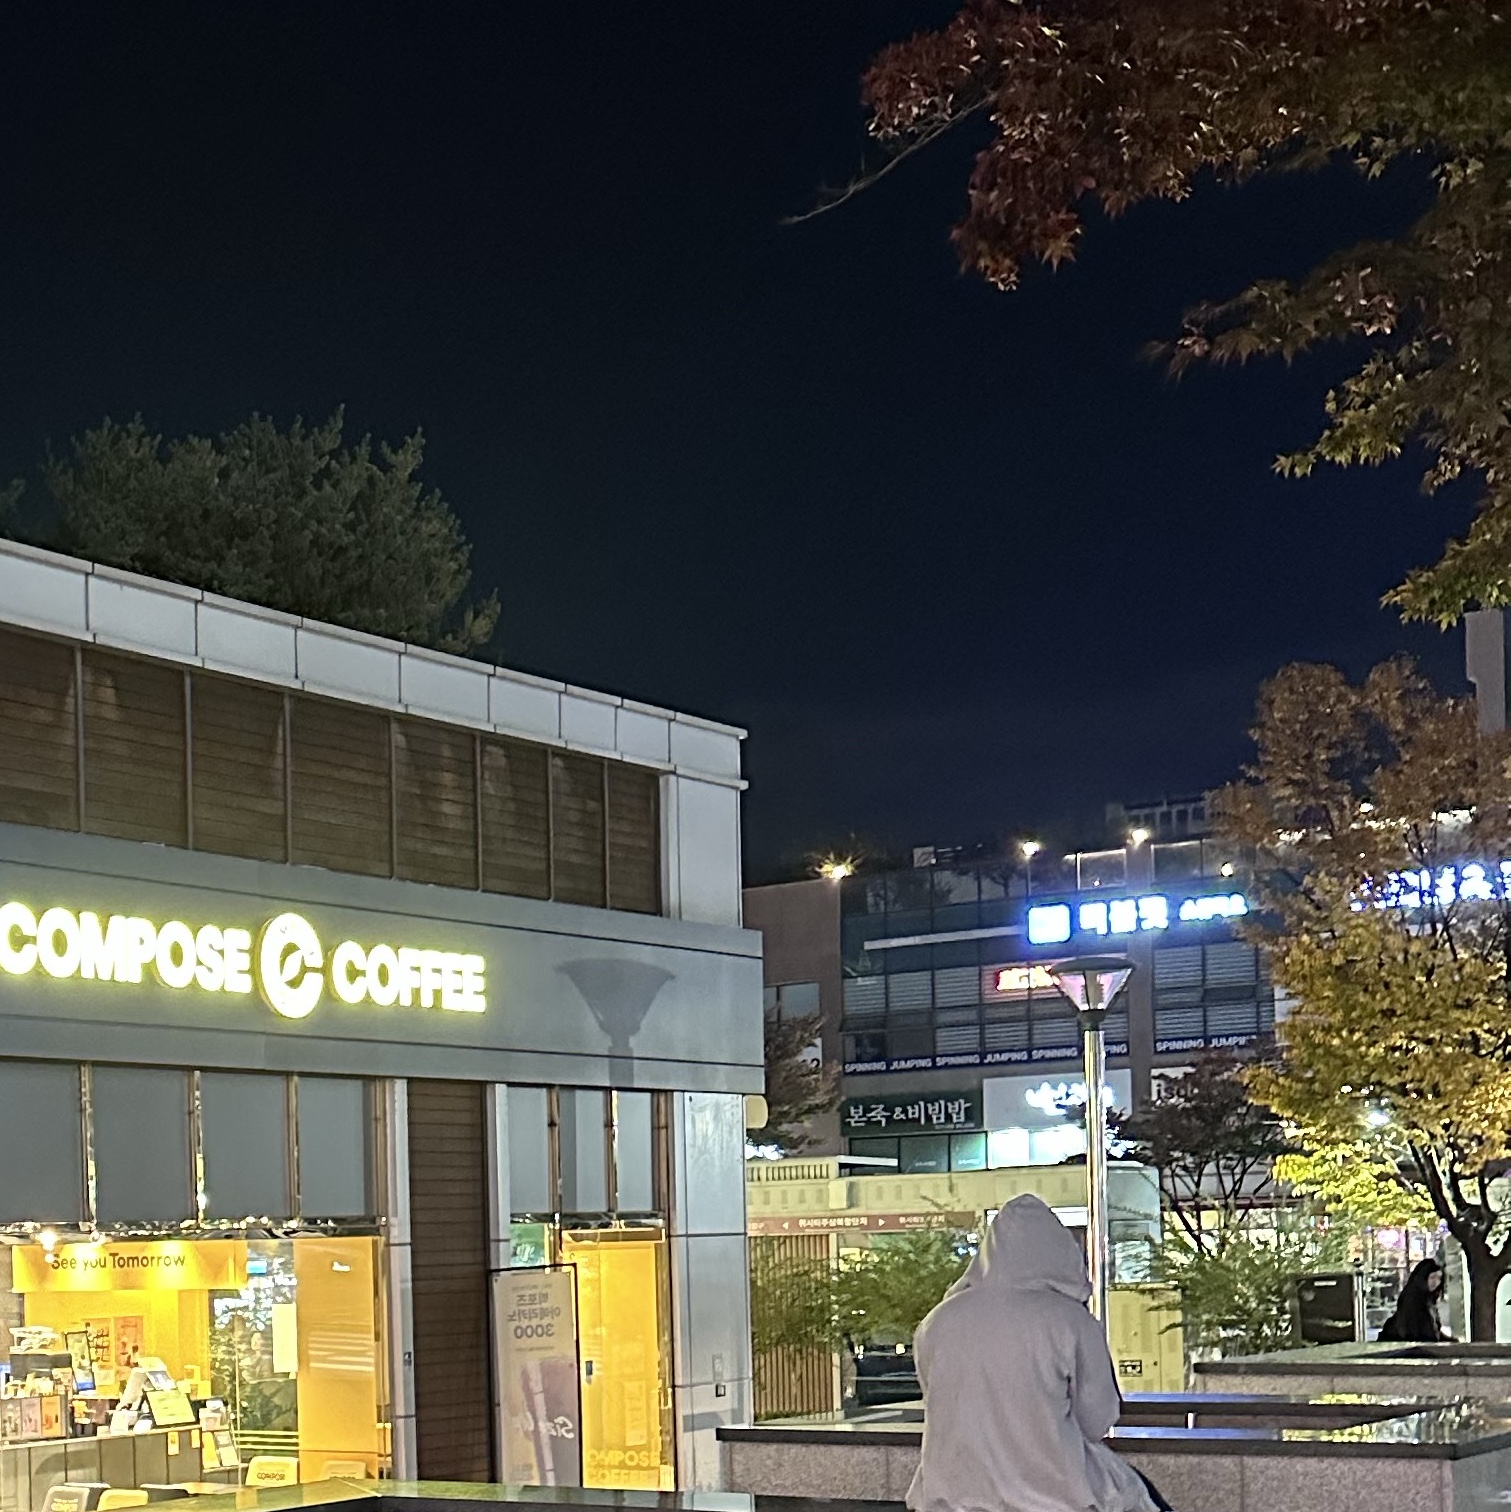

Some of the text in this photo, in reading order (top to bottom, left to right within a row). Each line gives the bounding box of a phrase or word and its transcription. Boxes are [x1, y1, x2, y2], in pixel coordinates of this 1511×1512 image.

[330, 940, 487, 1013] COFFEE
[1156, 1039, 1205, 1051] SPINNING
[889, 1058, 932, 1071] JUMPING
[935, 1055, 980, 1067] SPINNING
[983, 1051, 1028, 1064] JUMPING
[1031, 1047, 1078, 1060] SPINNING
[845, 1098, 972, 1127] 본죽&비빔밥
[51, 1252, 186, 1271] See you Tomorrow
